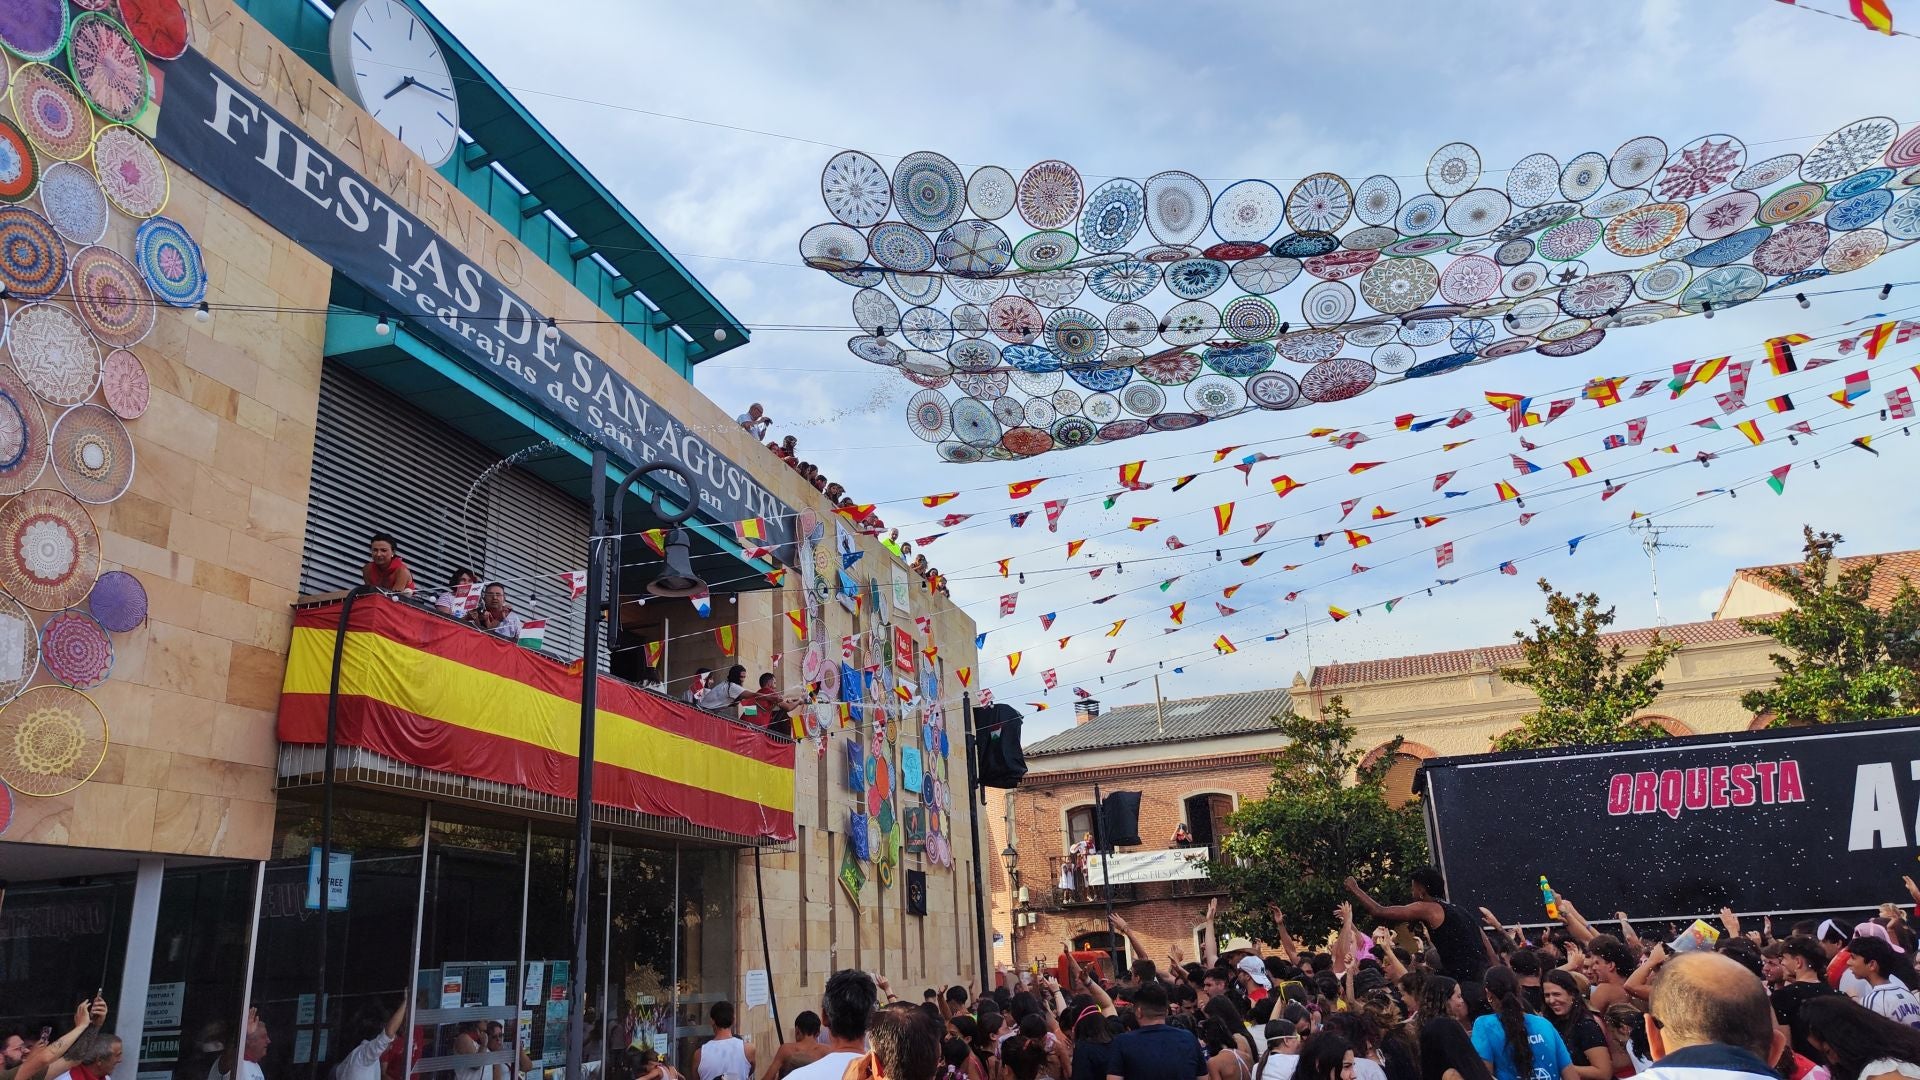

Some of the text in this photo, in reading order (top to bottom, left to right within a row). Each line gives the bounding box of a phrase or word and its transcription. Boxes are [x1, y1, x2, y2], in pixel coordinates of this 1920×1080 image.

[203, 71, 788, 533] FIESTAS DE SAN AGUSTIN
[386, 263, 538, 386] Pedrajas
[546, 380, 580, 413] de
[587, 405, 634, 453] San
[1607, 759, 1920, 852] ORQUESTA A
[150, 1041, 178, 1052] ENTRADA
